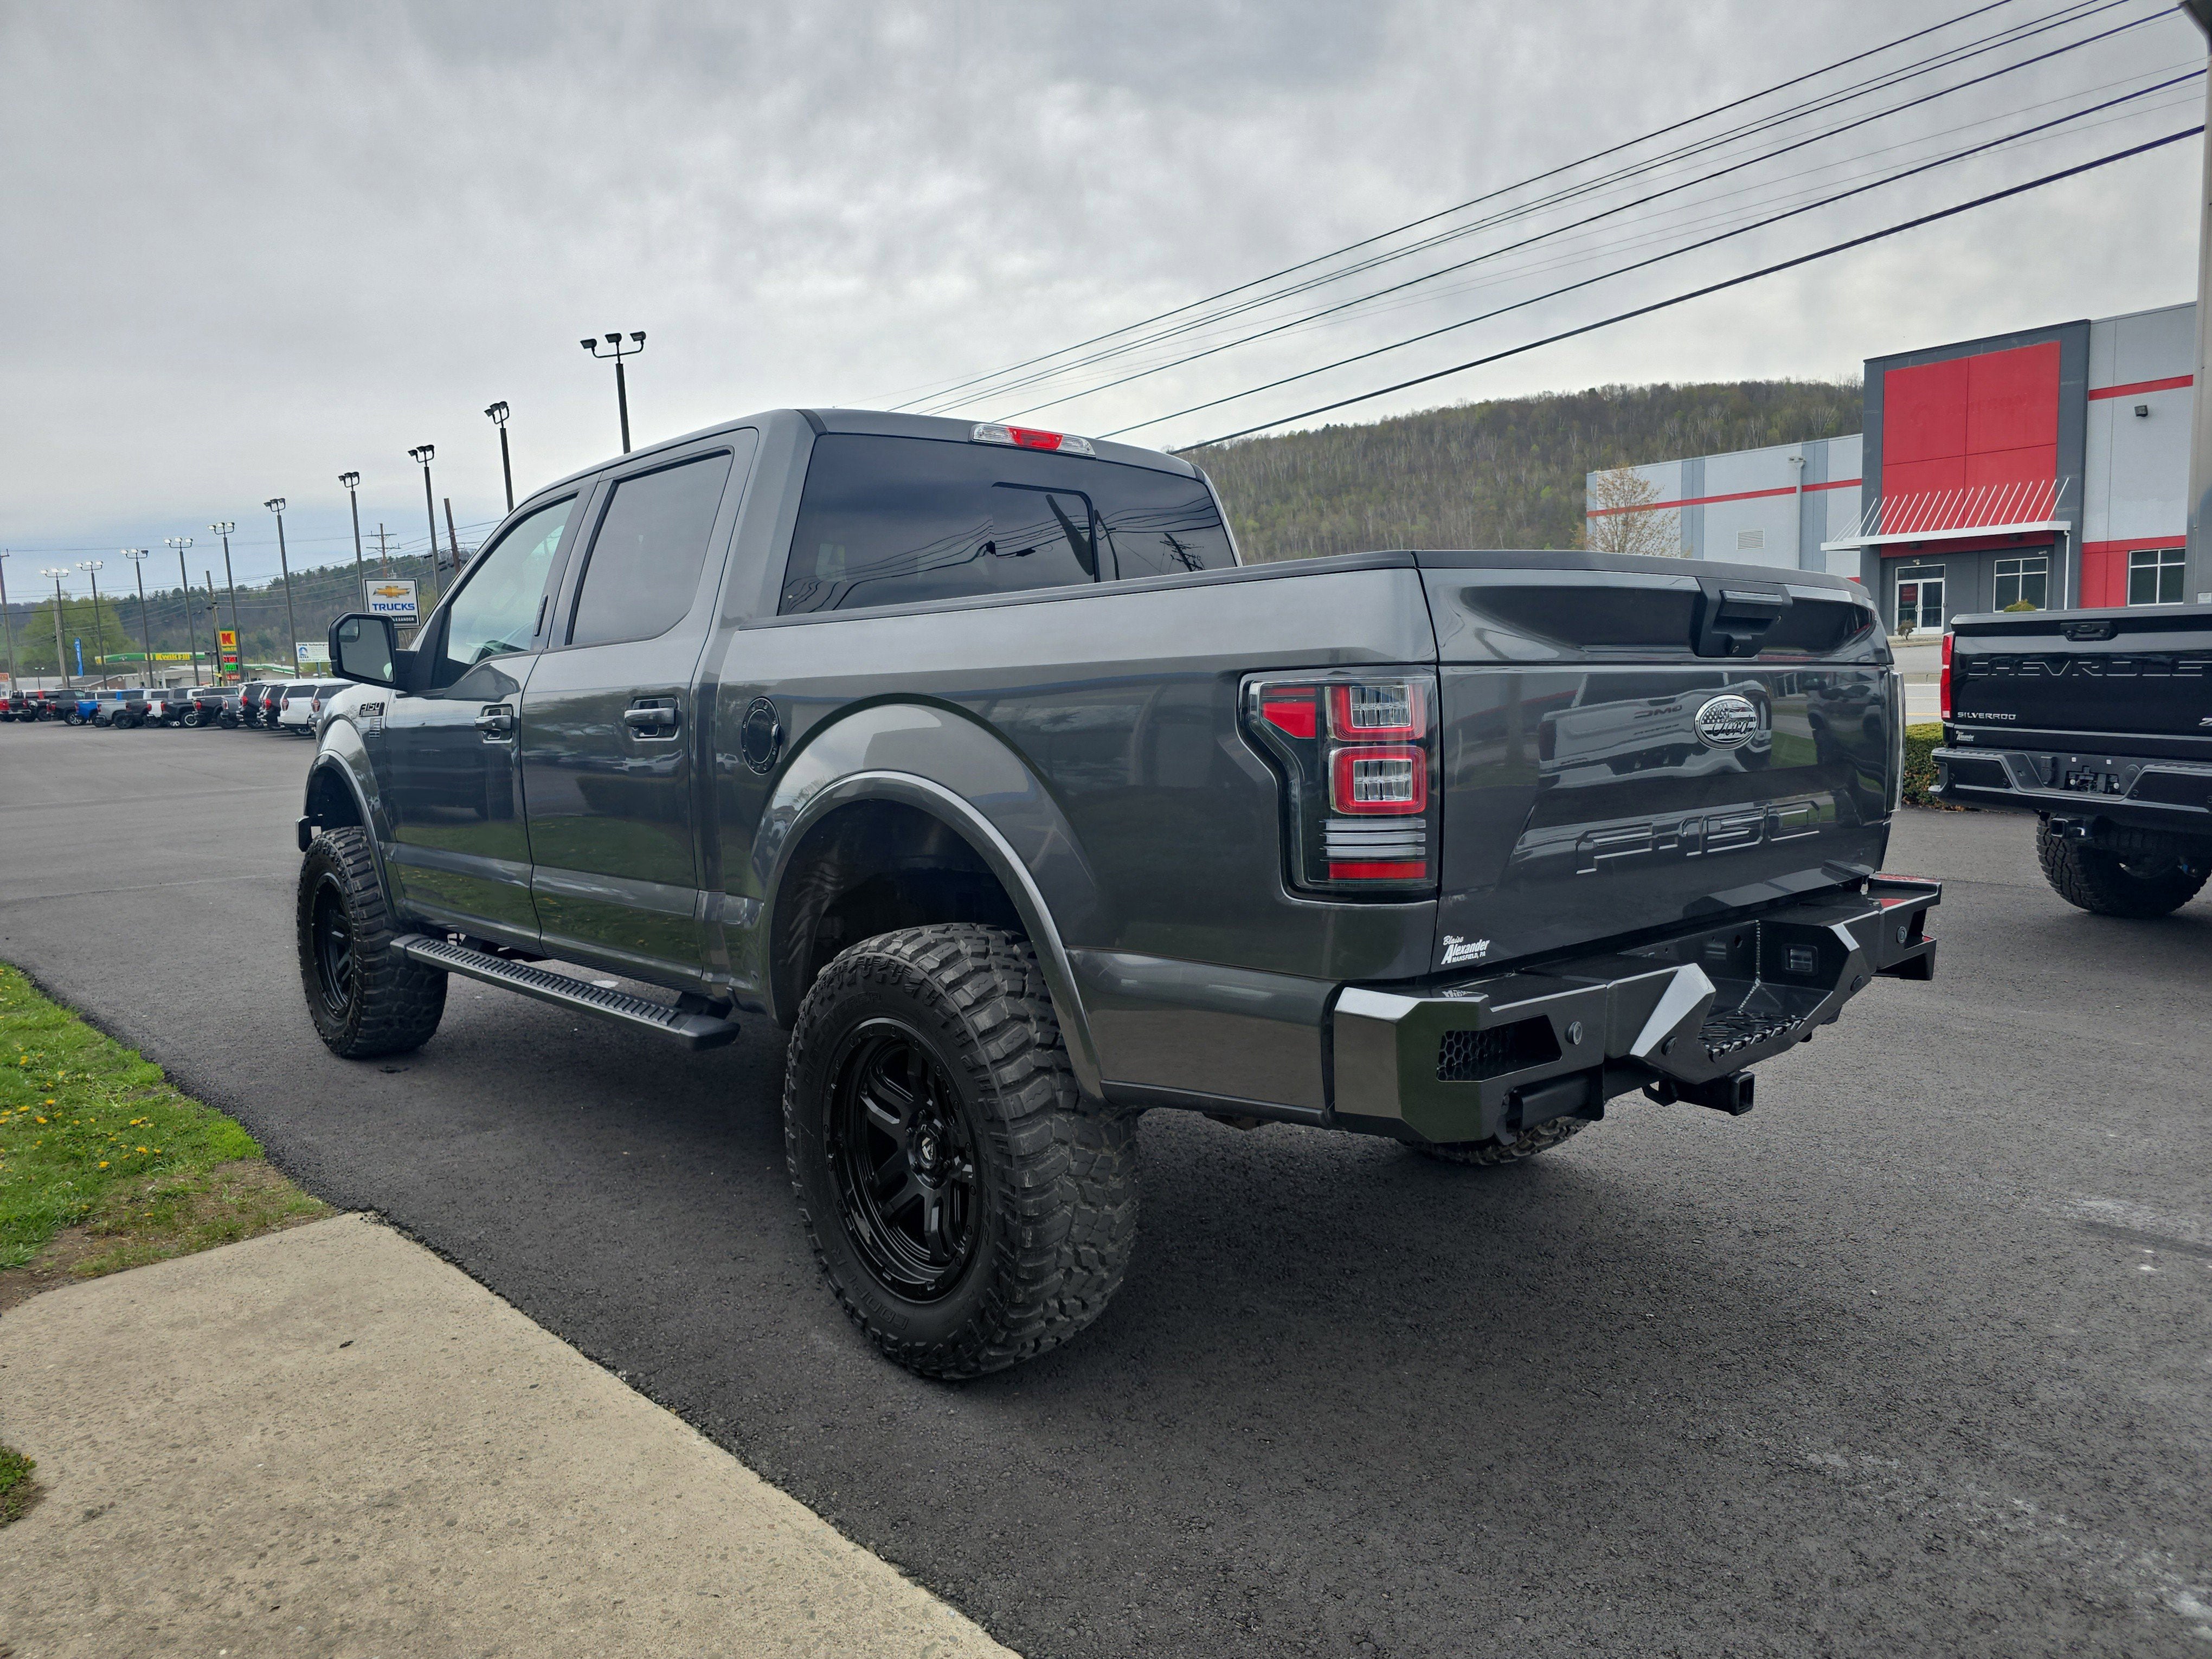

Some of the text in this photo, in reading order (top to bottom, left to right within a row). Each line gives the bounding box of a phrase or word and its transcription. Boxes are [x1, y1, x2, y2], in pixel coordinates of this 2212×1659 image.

[221, 633, 233, 644] K
[1969, 660, 2212, 677] CHEVROLE
[1712, 706, 1750, 736] Ford
[1957, 712, 2016, 720] SILVERADO
[1576, 801, 1820, 874] F-150
[1443, 935, 1464, 946] Blaise
[1441, 938, 1490, 965] Alexander
